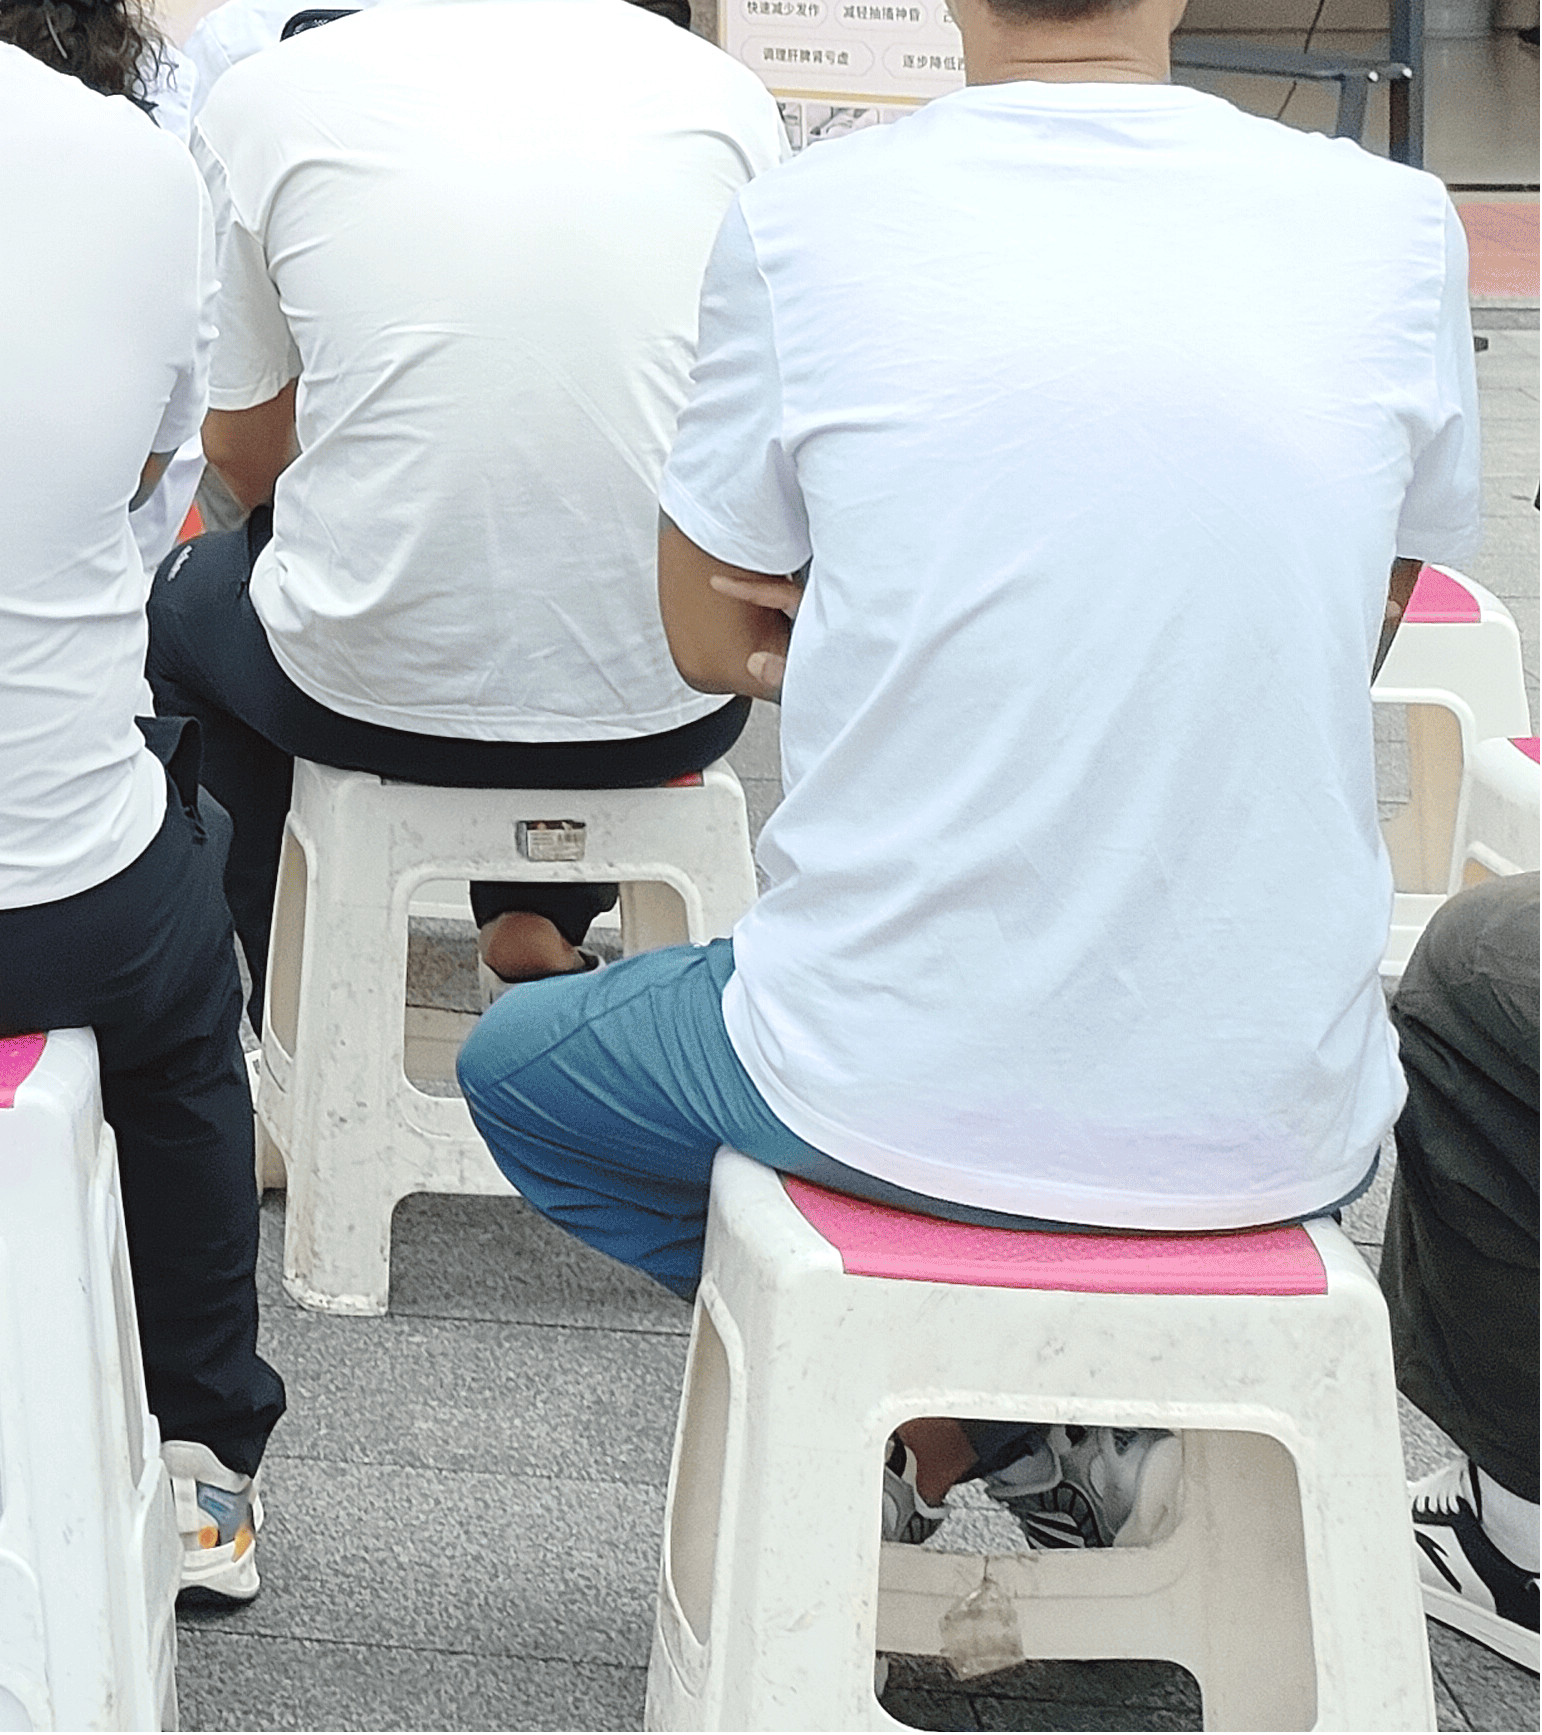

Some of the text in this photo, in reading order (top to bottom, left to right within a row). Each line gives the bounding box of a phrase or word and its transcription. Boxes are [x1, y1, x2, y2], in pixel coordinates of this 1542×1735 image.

[746, 0, 821, 18] 快速减少发作
